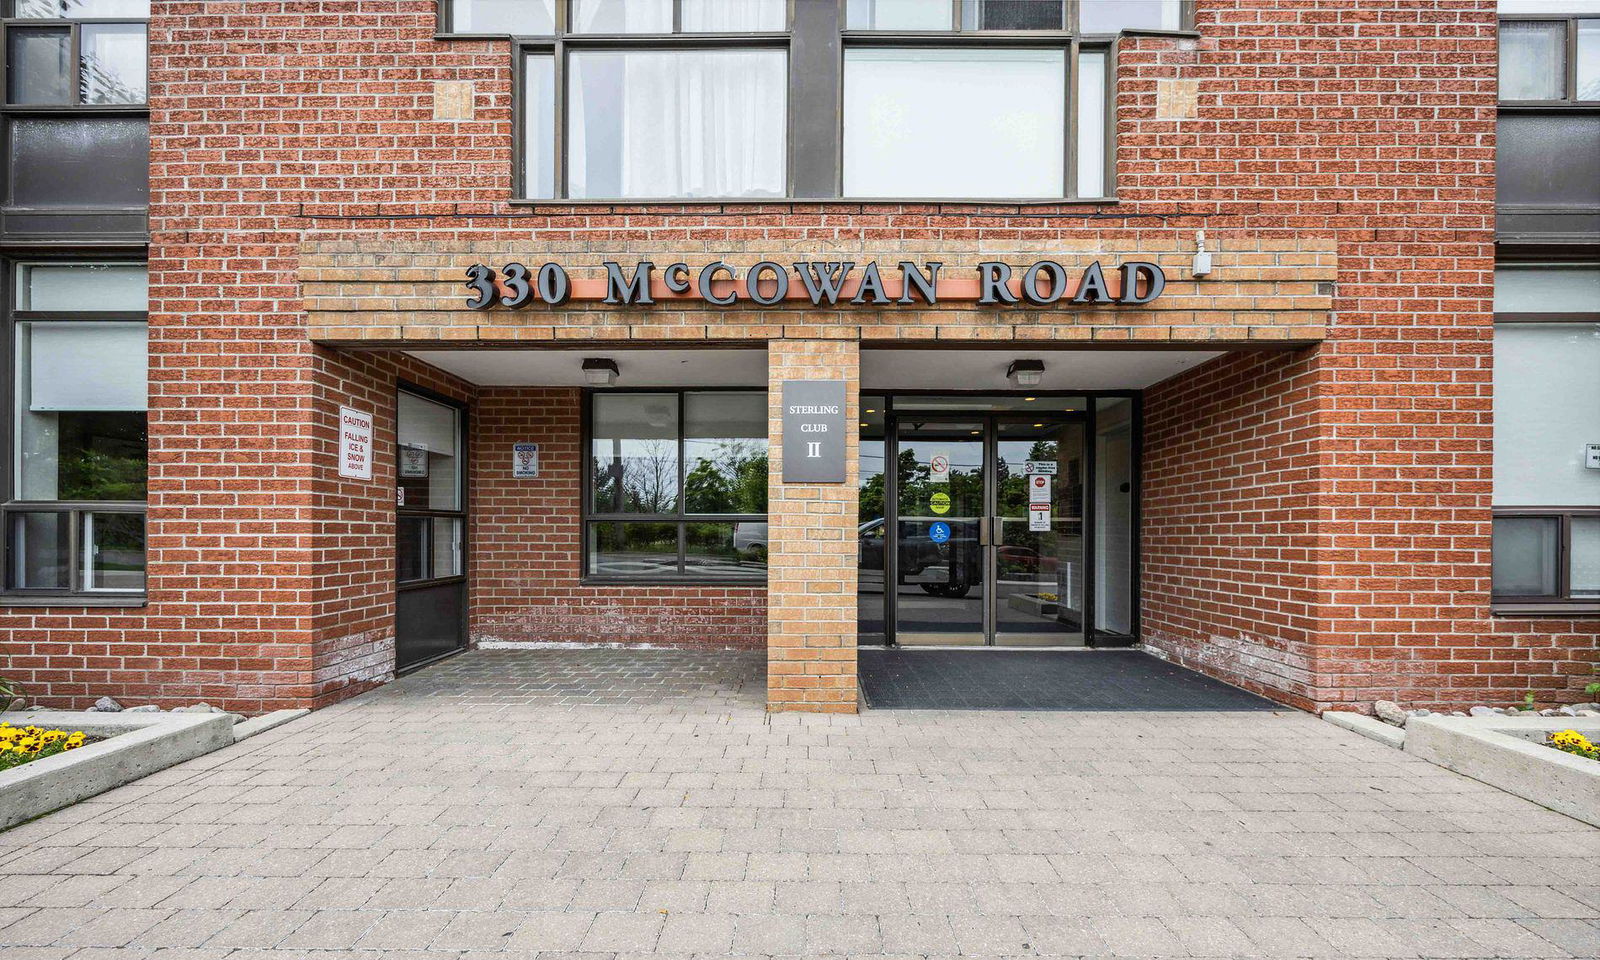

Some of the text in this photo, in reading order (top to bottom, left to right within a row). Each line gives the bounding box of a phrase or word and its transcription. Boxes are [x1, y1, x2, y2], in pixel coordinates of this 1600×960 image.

[465, 260, 1166, 310] 330 McCOWAN ROAD
[789, 405, 839, 415] STERLING
[343, 416, 370, 428] CAUTION
[800, 424, 828, 433] CLUB
[344, 431, 368, 444] FALLING
[348, 443, 364, 453] ICE &
[806, 442, 822, 458] II
[347, 452, 366, 463] SNOW
[347, 463, 364, 471] ABOVE
